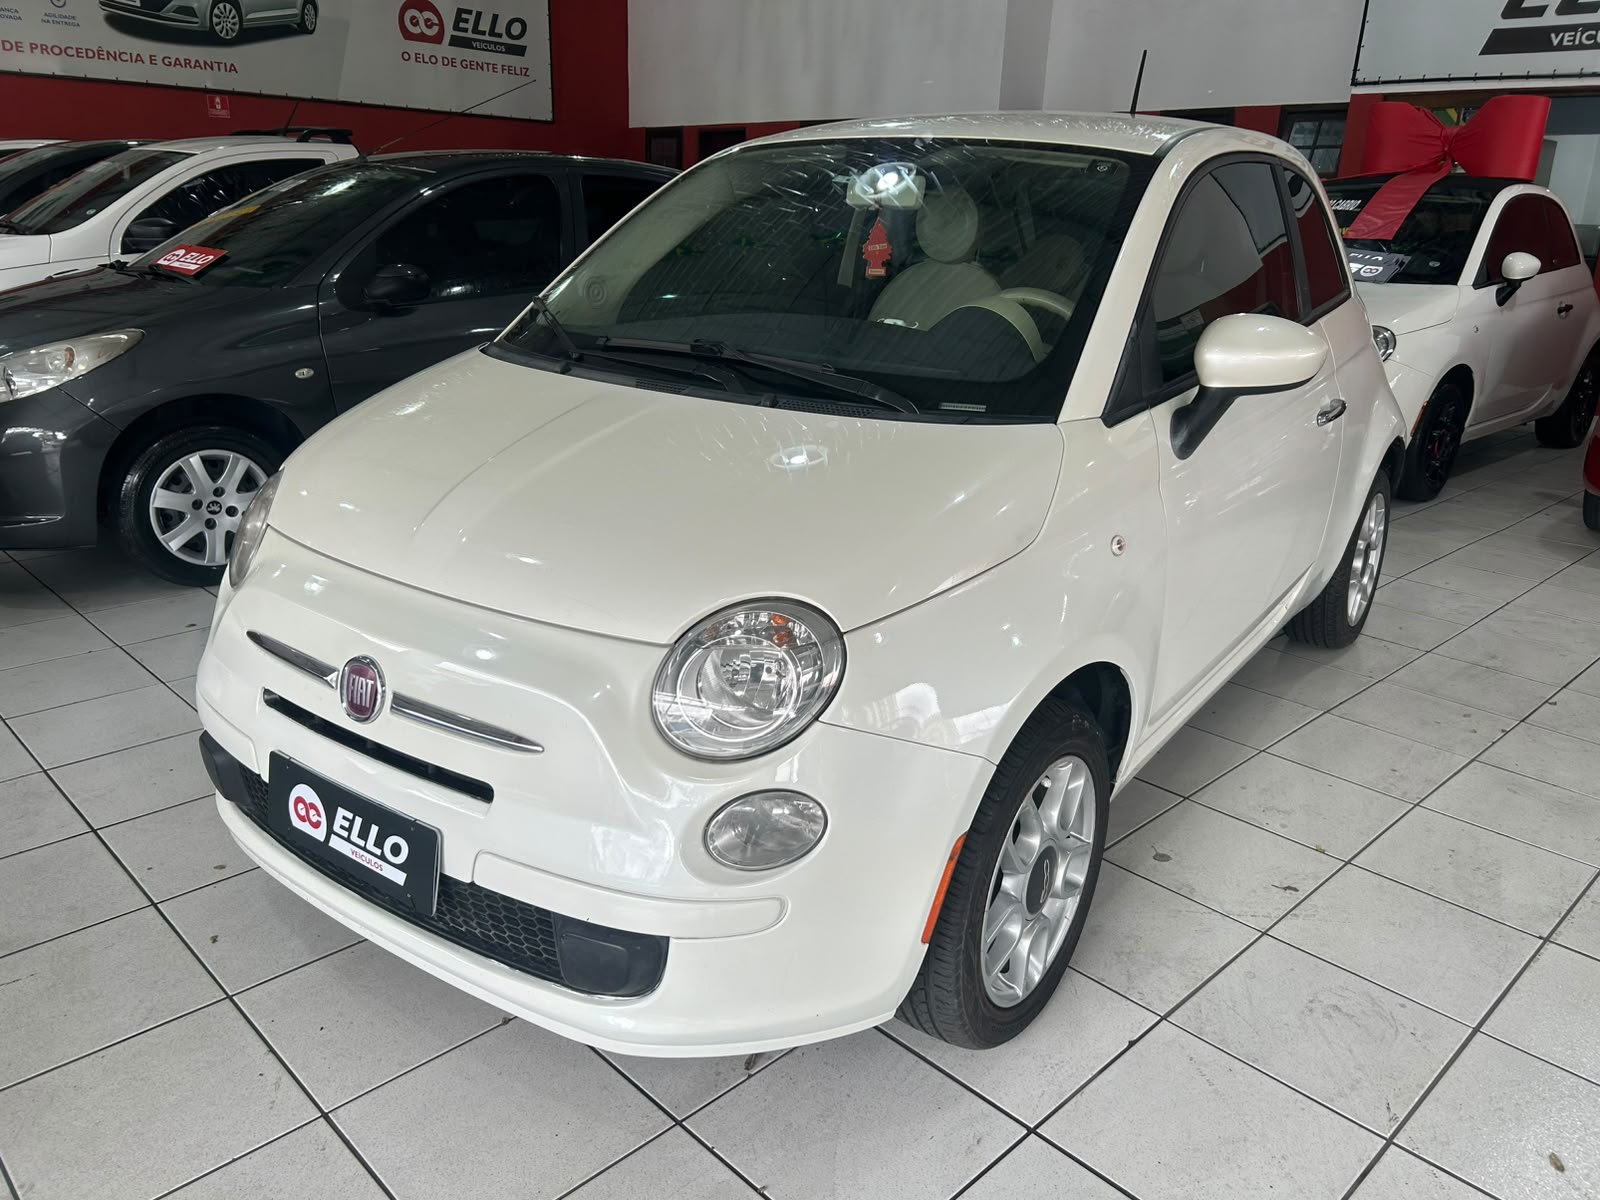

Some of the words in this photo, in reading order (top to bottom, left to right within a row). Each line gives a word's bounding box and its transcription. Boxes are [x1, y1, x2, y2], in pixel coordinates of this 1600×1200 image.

[43, 12, 77, 20] AGILIDADE
[452, 7, 528, 41] ELLO
[1, 39, 24, 53] DE
[29, 42, 145, 65] PROCEDÊNCIA
[149, 54, 158, 66] E
[161, 56, 239, 74] GARANTIA
[471, 40, 506, 52] VEÍCULOS
[401, 51, 411, 62] O
[414, 52, 438, 65] ELO
[441, 56, 457, 68] DE
[460, 59, 498, 73] GENTE
[501, 65, 530, 77] FELIZ
[179, 252, 214, 264] ELLO
[350, 675, 374, 707] FIAT
[332, 806, 409, 864] ELLO
[350, 848, 384, 873] VEÍCULOS
